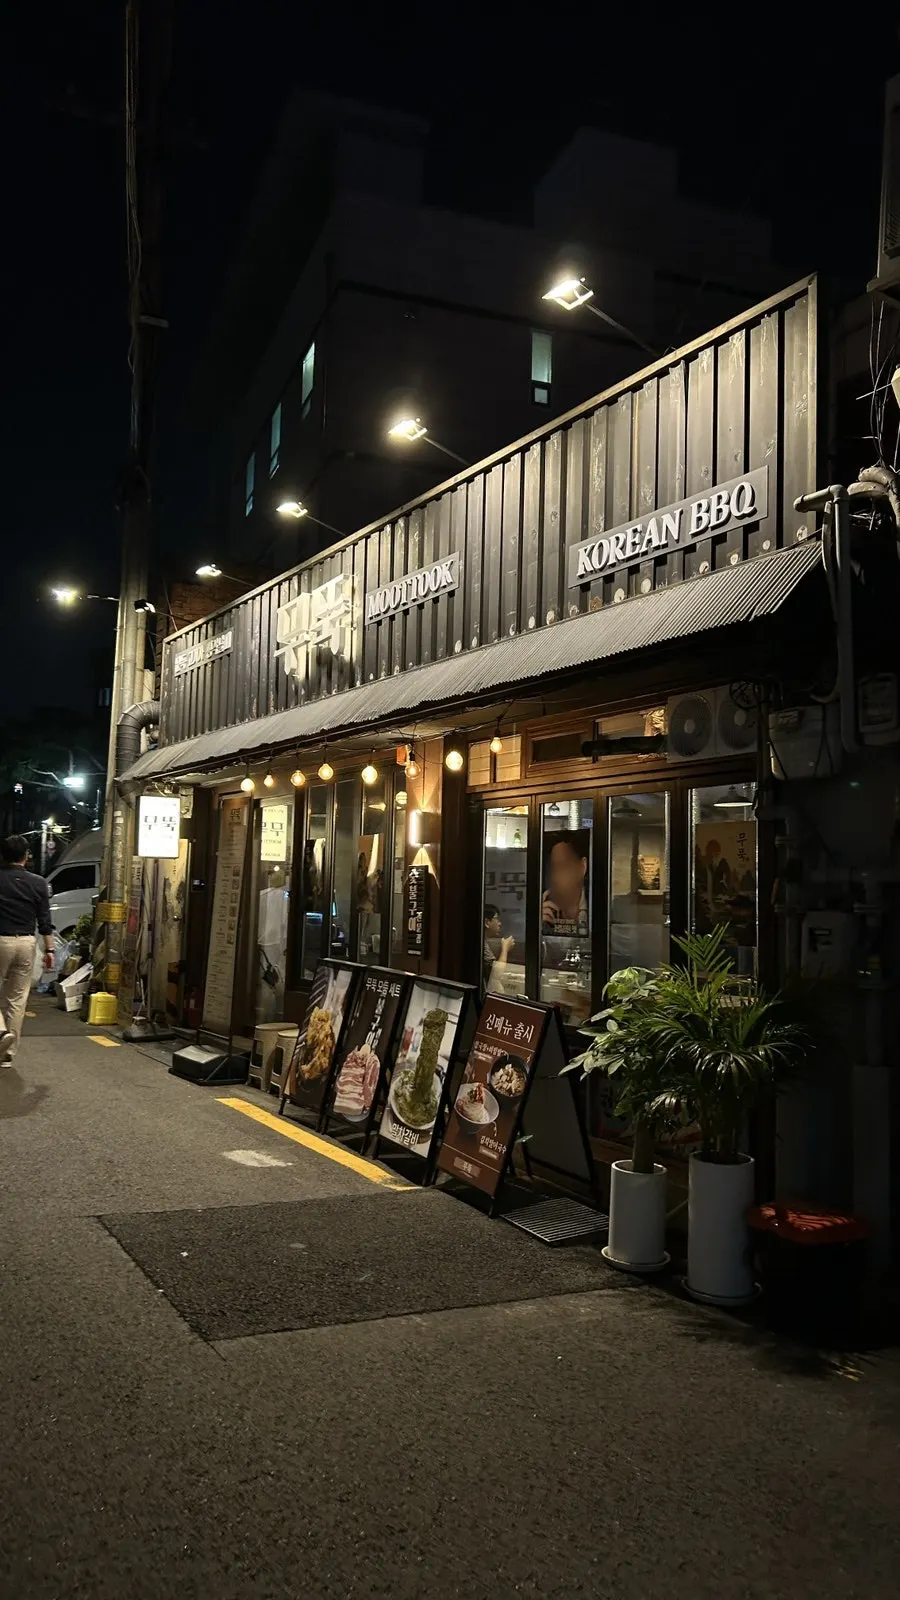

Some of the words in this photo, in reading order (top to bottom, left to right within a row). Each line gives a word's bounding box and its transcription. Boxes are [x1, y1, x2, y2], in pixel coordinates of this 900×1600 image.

[577, 510, 683, 578] KOREAN
[689, 482, 757, 536] BBQ
[368, 558, 456, 620] MOOTTOOK
[144, 815, 177, 832] 무뚝
[365, 977, 378, 993] 무뚝
[376, 979, 390, 997] 모듬
[388, 982, 402, 998] 세트
[485, 1013, 513, 1036] 신메뉴
[513, 1022, 535, 1043] 출시
